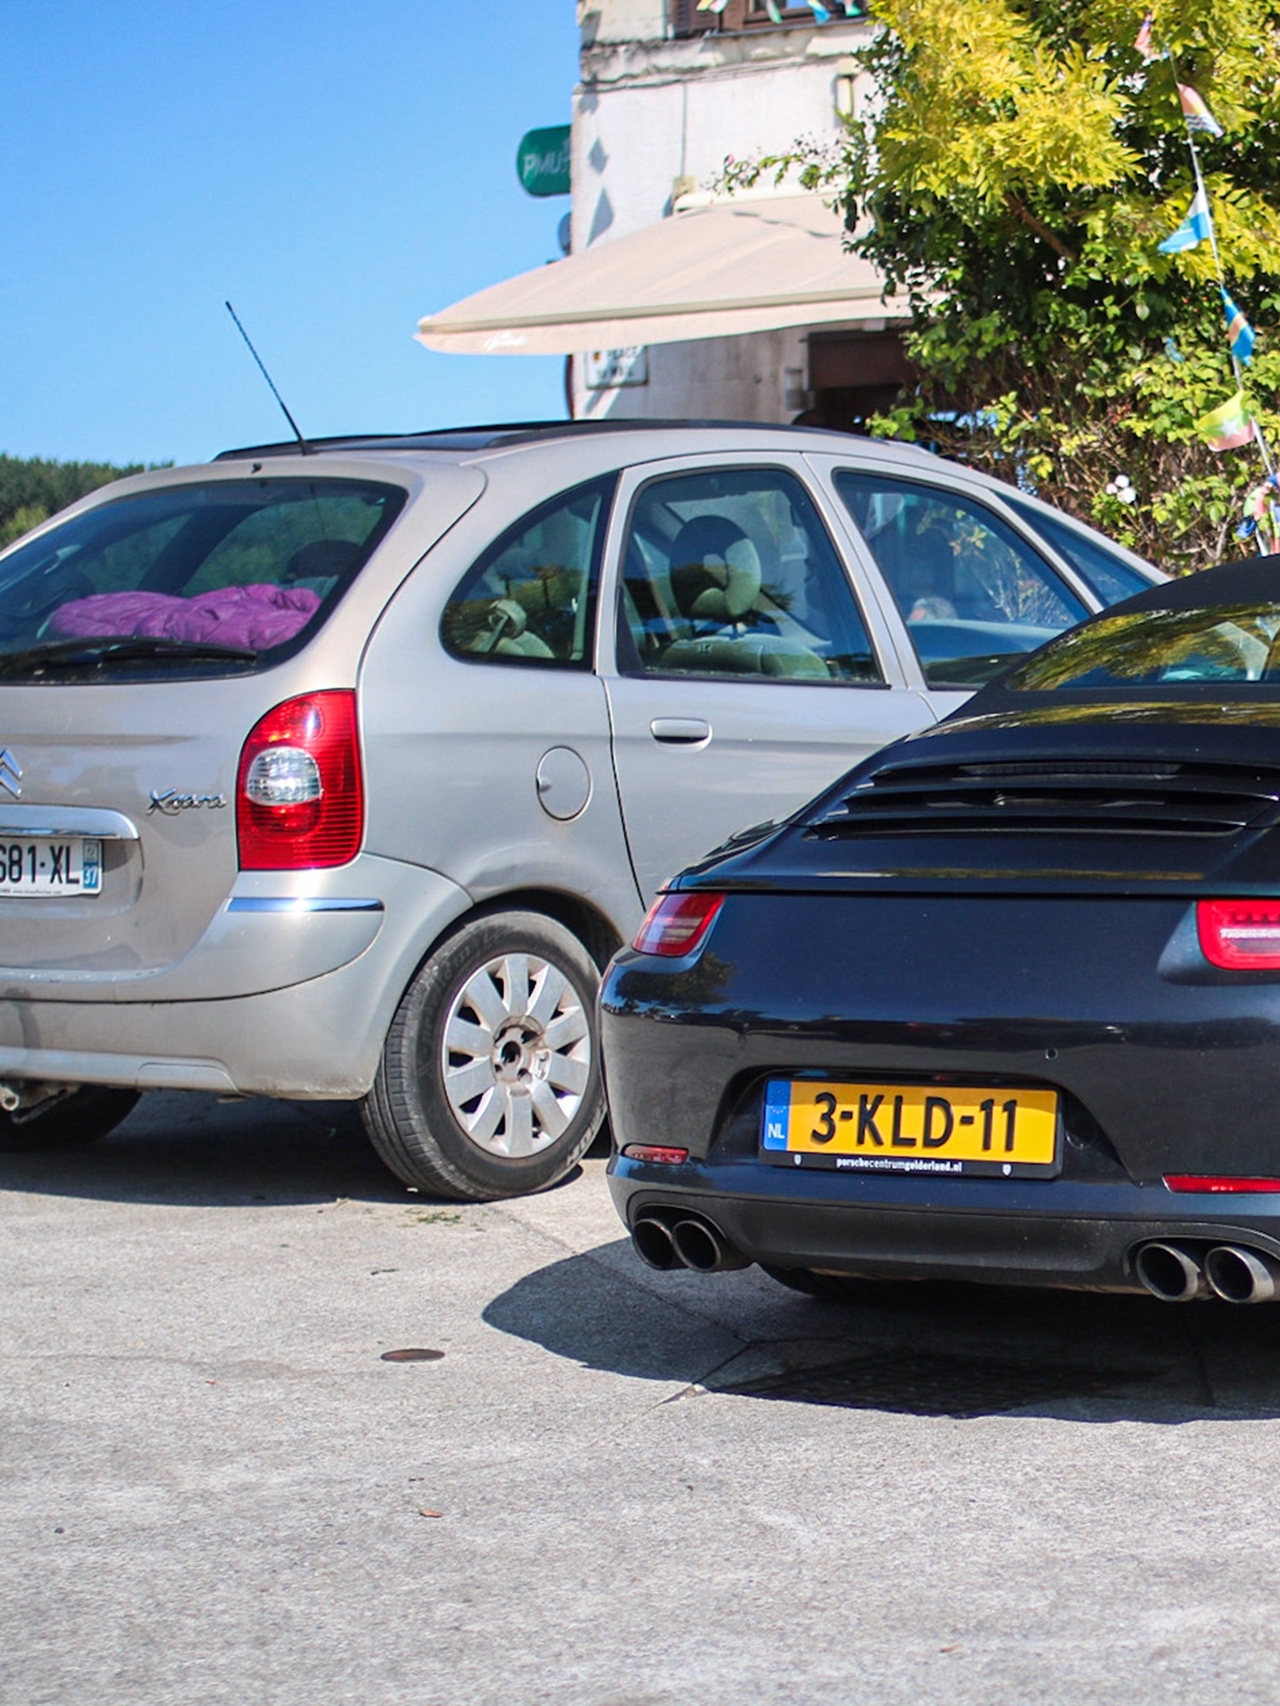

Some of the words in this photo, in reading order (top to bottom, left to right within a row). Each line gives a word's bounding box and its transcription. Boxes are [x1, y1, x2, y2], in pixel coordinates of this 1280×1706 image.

[523, 151, 562, 179] PMU
[767, 1123, 785, 1139] NL
[811, 1091, 1018, 1152] 3-KLD-11
[836, 1157, 963, 1172] porschecentrumgelderland.nl
